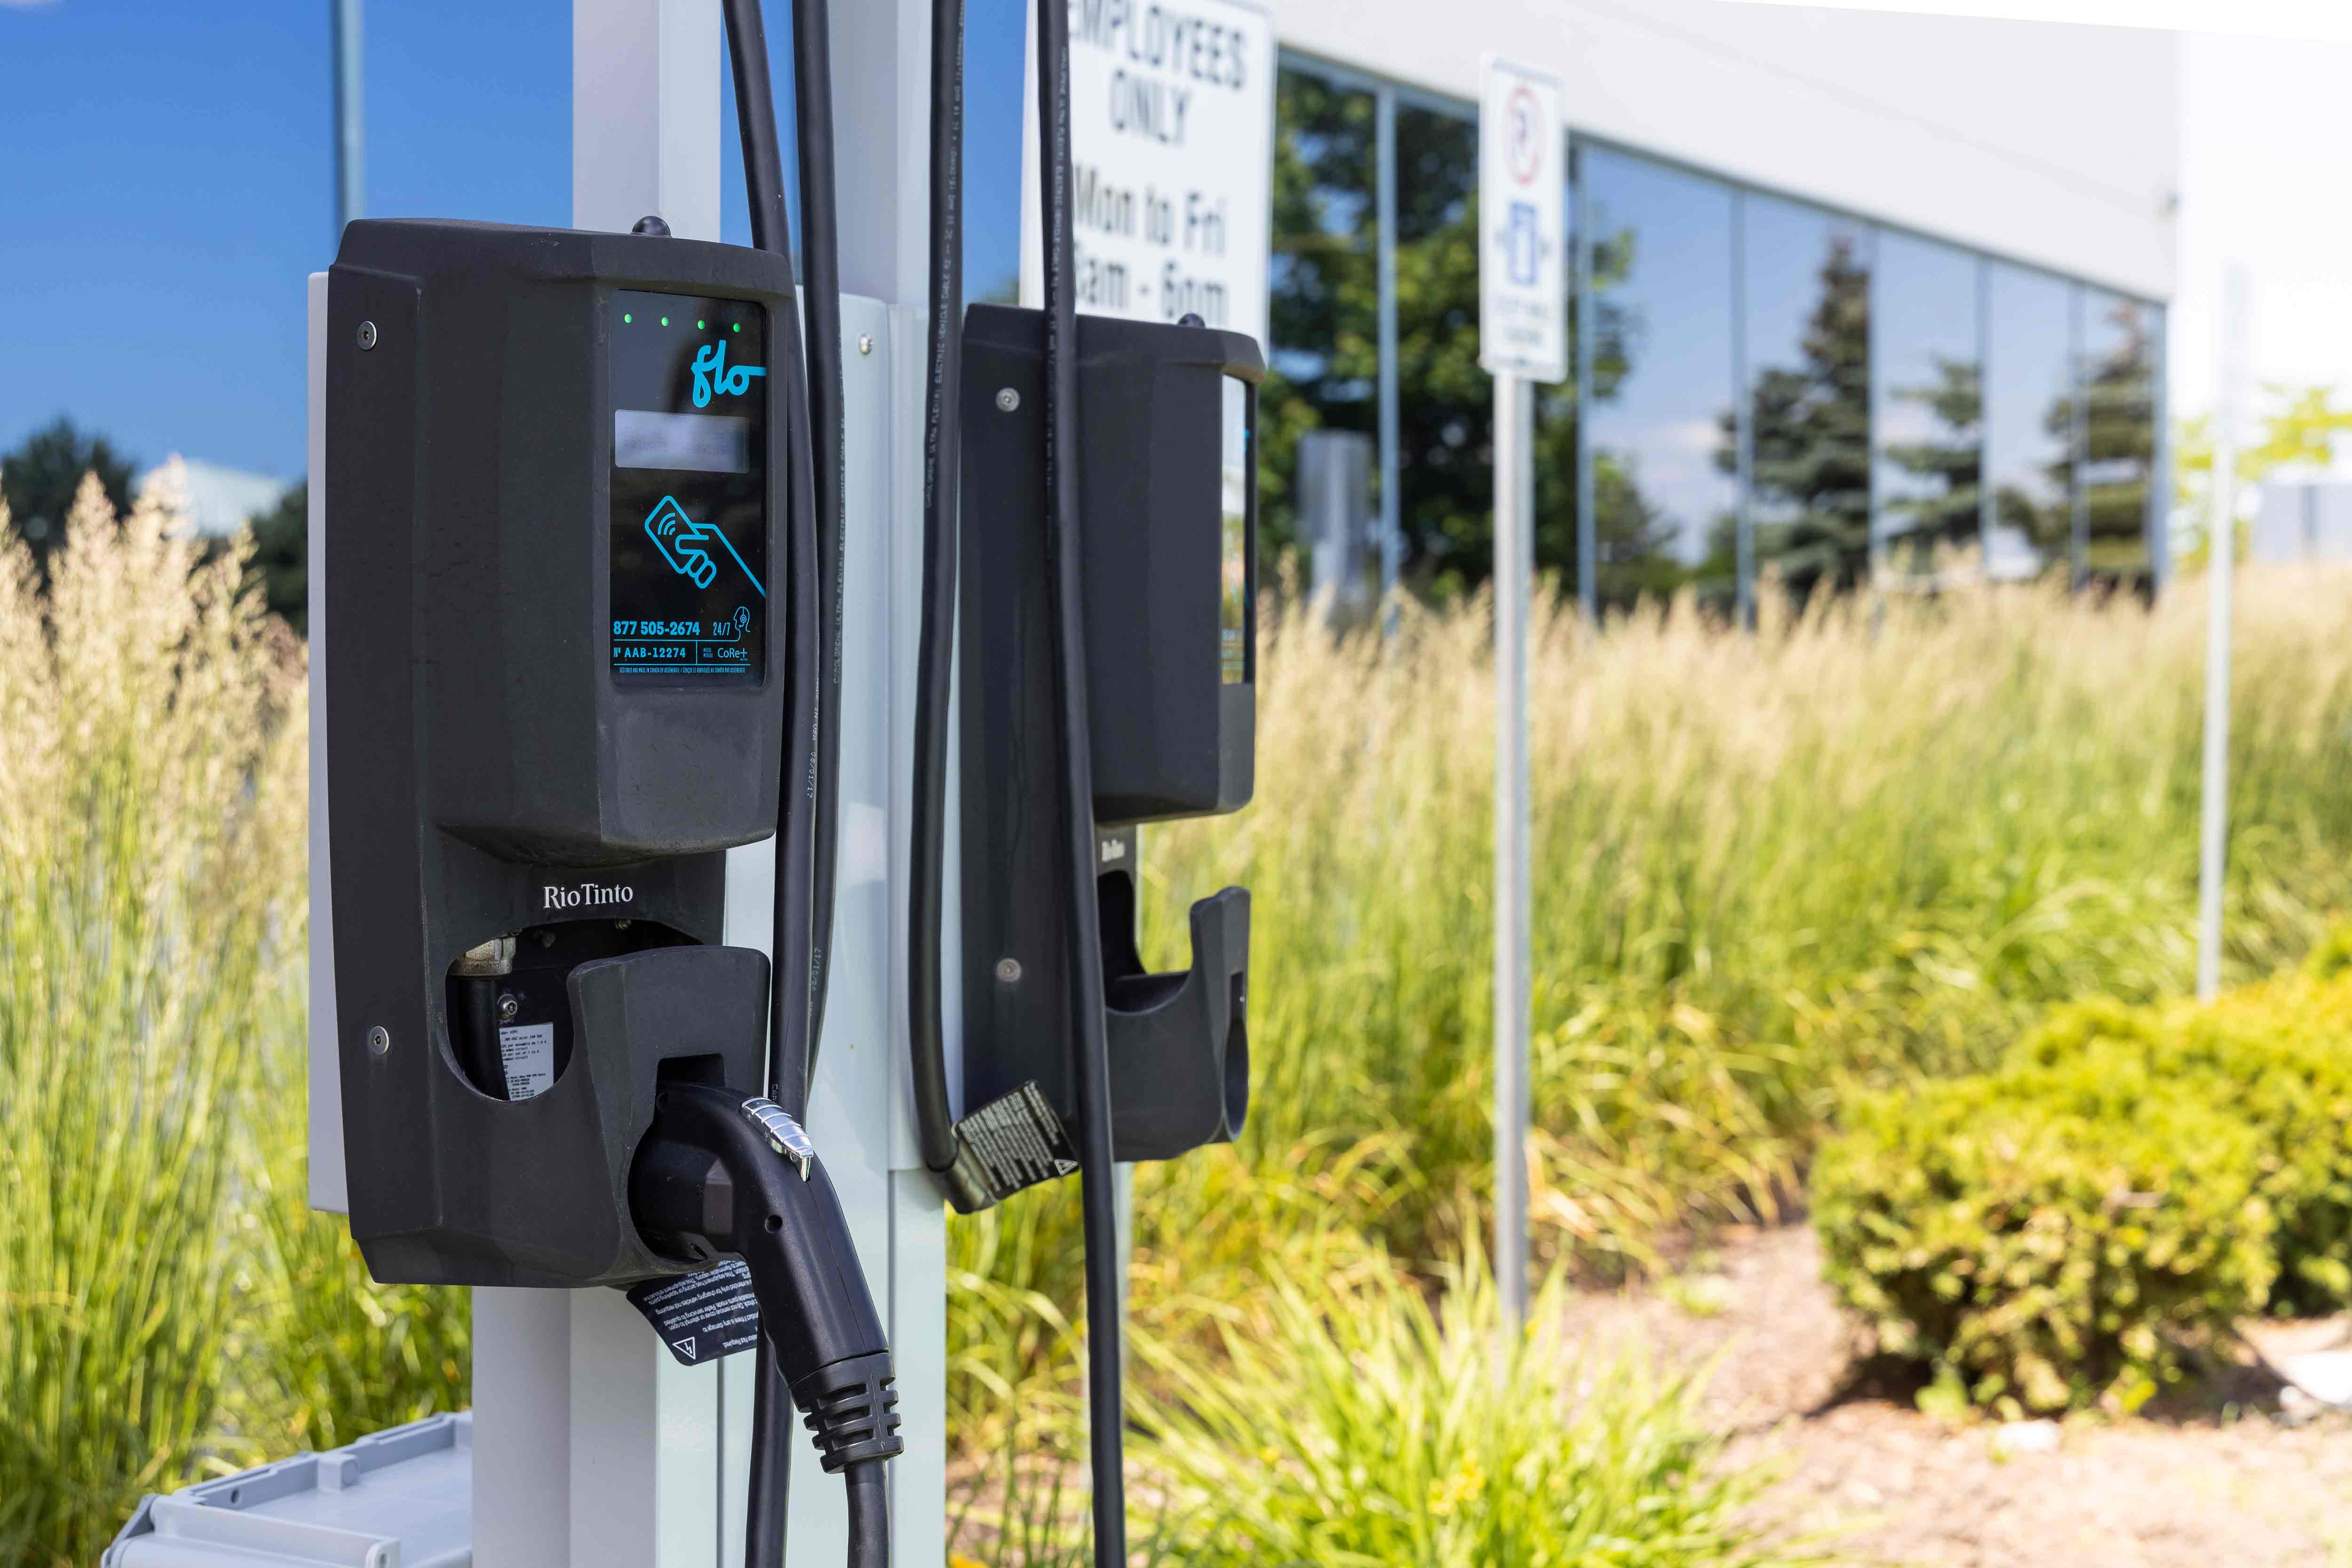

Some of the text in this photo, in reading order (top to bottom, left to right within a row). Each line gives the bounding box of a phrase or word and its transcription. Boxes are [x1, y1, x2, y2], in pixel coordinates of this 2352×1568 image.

[1111, 68, 1192, 145] ONLY
[1074, 164, 1225, 256] Mon to Fri
[691, 340, 766, 407] flo
[613, 621, 730, 636] 877 505-2674 24/7
[624, 647, 686, 658] AAB-12274
[717, 648, 747, 658] CoRe+
